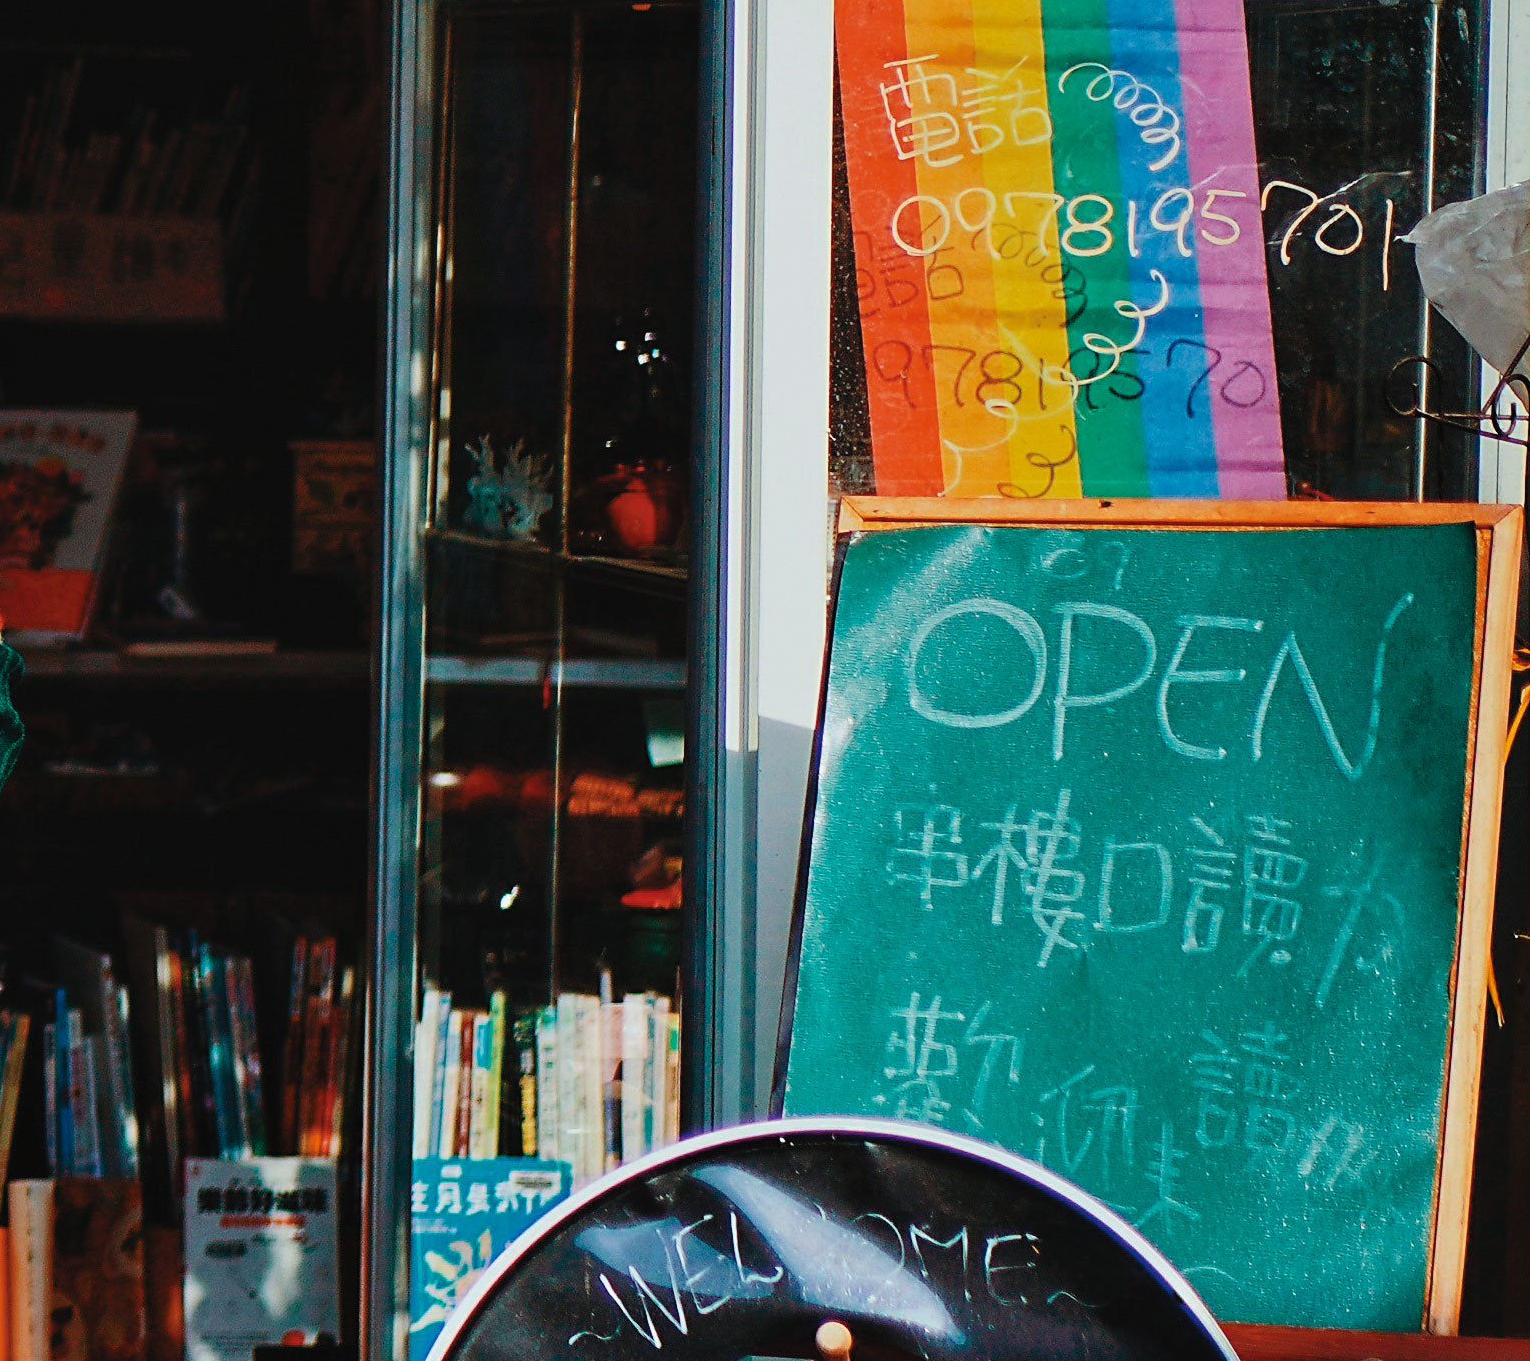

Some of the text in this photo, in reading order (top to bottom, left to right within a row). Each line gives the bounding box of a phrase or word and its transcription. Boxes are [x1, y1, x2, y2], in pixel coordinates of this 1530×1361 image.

[880, 53, 1053, 169] 電話
[892, 179, 1394, 291] 0978195701
[907, 593, 1414, 781] OPEN
[599, 1210, 1040, 1350] WELOME
